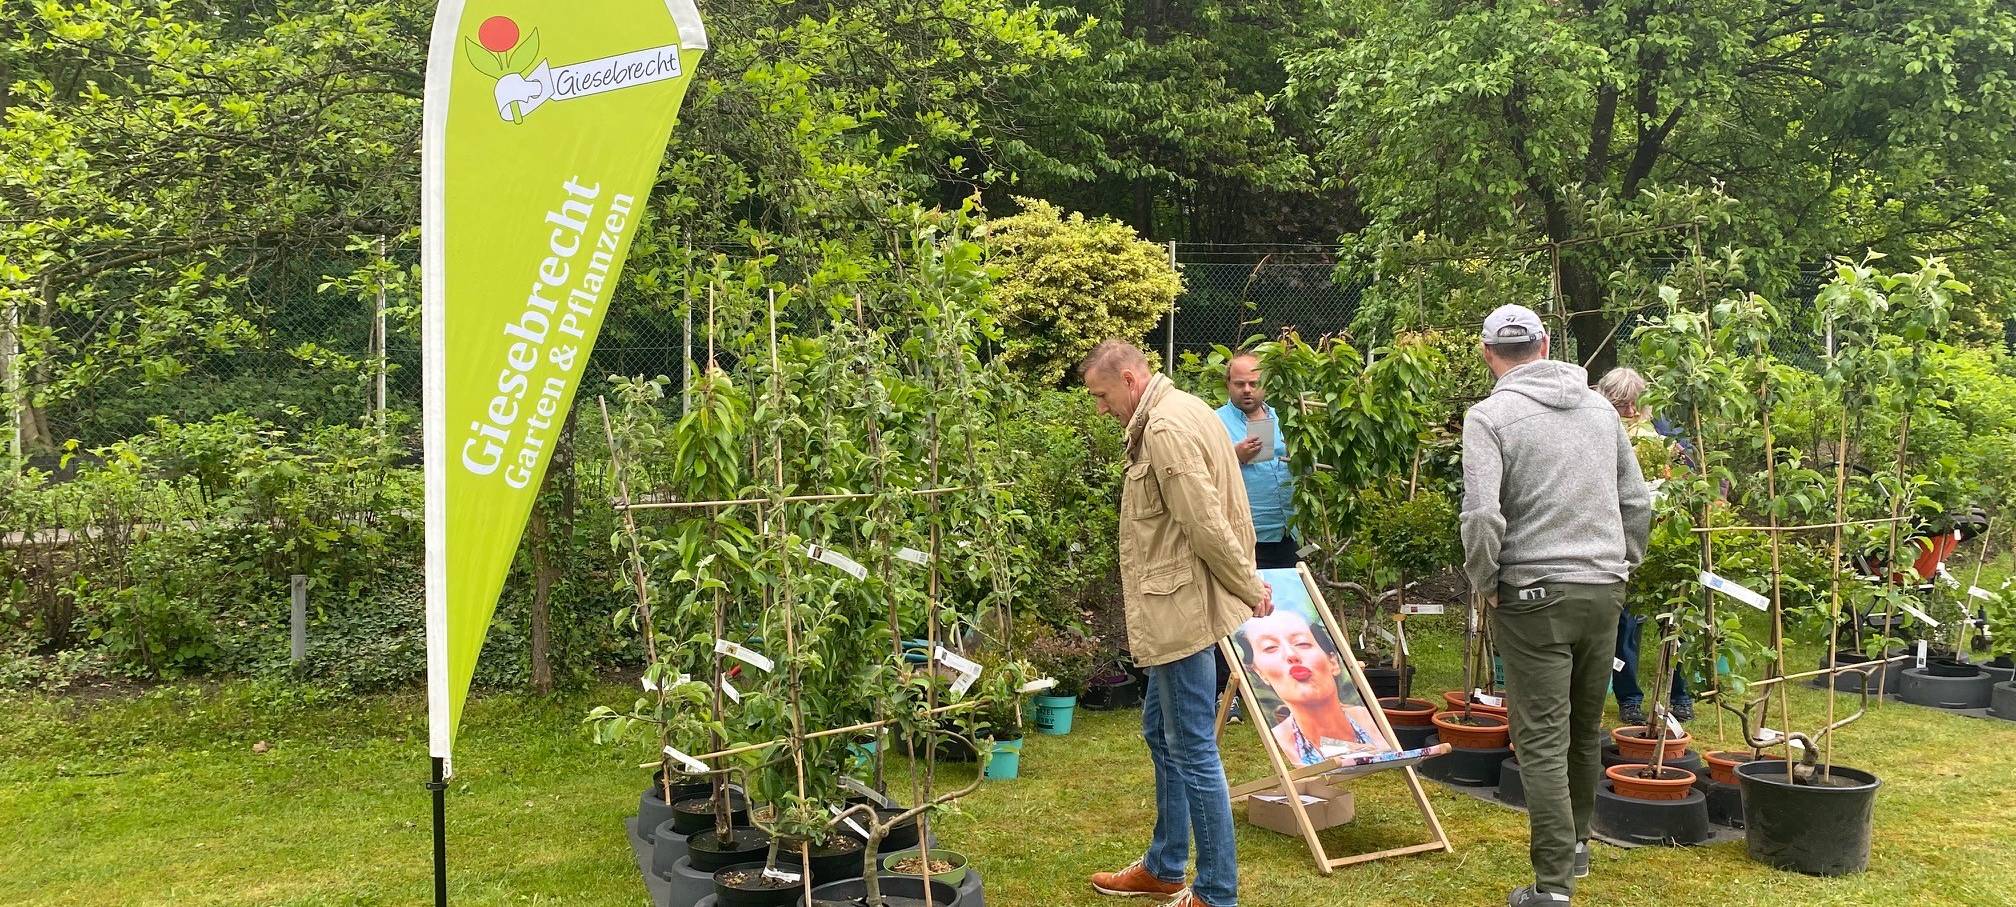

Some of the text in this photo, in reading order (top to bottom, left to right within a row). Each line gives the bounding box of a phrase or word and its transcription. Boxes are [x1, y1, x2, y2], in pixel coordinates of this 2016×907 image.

[556, 51, 678, 97] Giesebrecht
[462, 175, 600, 477] Giesebrecht
[504, 192, 635, 490] Garten & Pflanzen
